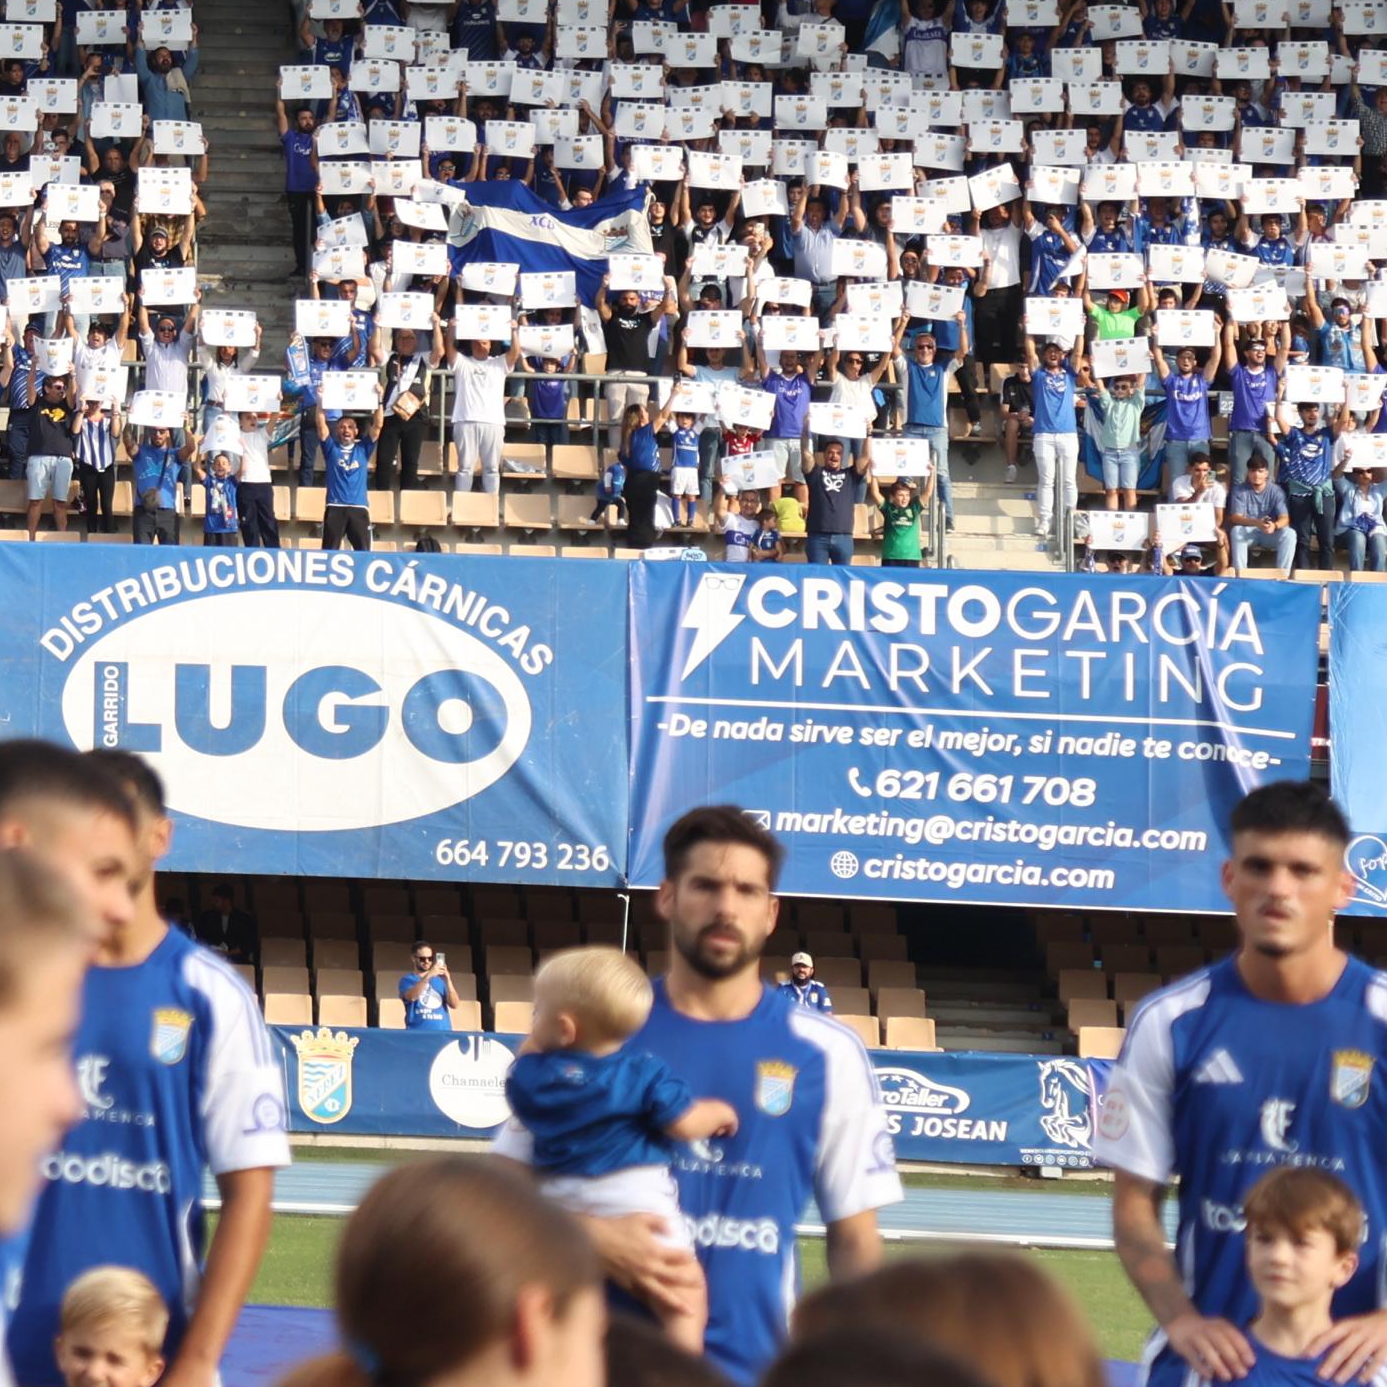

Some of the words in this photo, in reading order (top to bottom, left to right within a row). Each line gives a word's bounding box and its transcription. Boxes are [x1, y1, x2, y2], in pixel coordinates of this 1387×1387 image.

[40, 551, 355, 663] DISTRIBUCIONES
[365, 559, 554, 676] CÁRNICAS
[750, 636, 1264, 713] MARKETING
[93, 660, 509, 764] LUGO
[103, 665, 119, 748] GARRIDO
[713, 718, 780, 742] nada
[789, 720, 852, 745] sirve
[859, 727, 902, 747] ser
[908, 725, 933, 748] el
[938, 728, 1022, 756] mejor,
[1028, 730, 1051, 753] si
[1058, 732, 1137, 757] nadie
[1143, 738, 1172, 759] te
[875, 770, 941, 799] 621
[948, 772, 1016, 803] 661
[1022, 775, 1097, 807] 708
[776, 808, 1207, 852] marketing@cristogarcia.com
[435, 839, 488, 866] 664
[496, 841, 548, 869] 793
[556, 843, 609, 872] 236
[864, 854, 1115, 890] cristogarcia.com
[307, 1063, 348, 1106] XEREZ
[441, 1074, 508, 1088] Chamaele
[881, 1086, 950, 1108] roTaller
[911, 1117, 1008, 1142] JOSEAN
